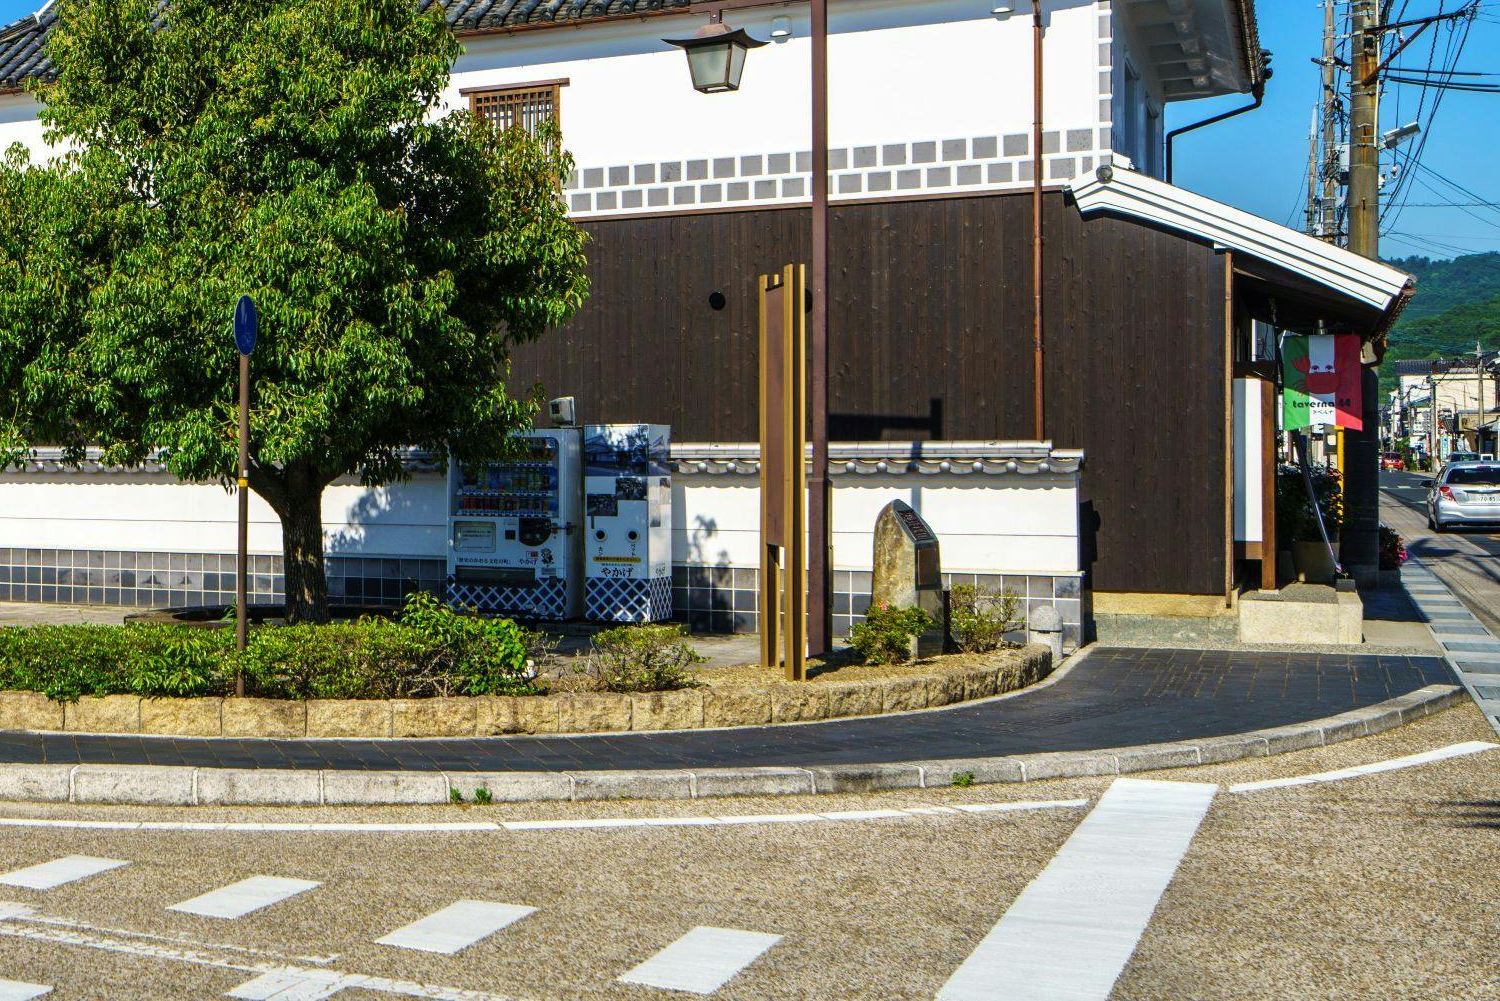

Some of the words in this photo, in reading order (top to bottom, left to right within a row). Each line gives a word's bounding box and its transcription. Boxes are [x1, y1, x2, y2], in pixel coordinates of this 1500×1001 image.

[1293, 400, 1334, 408] taverna
[601, 567, 634, 578] やかげ
